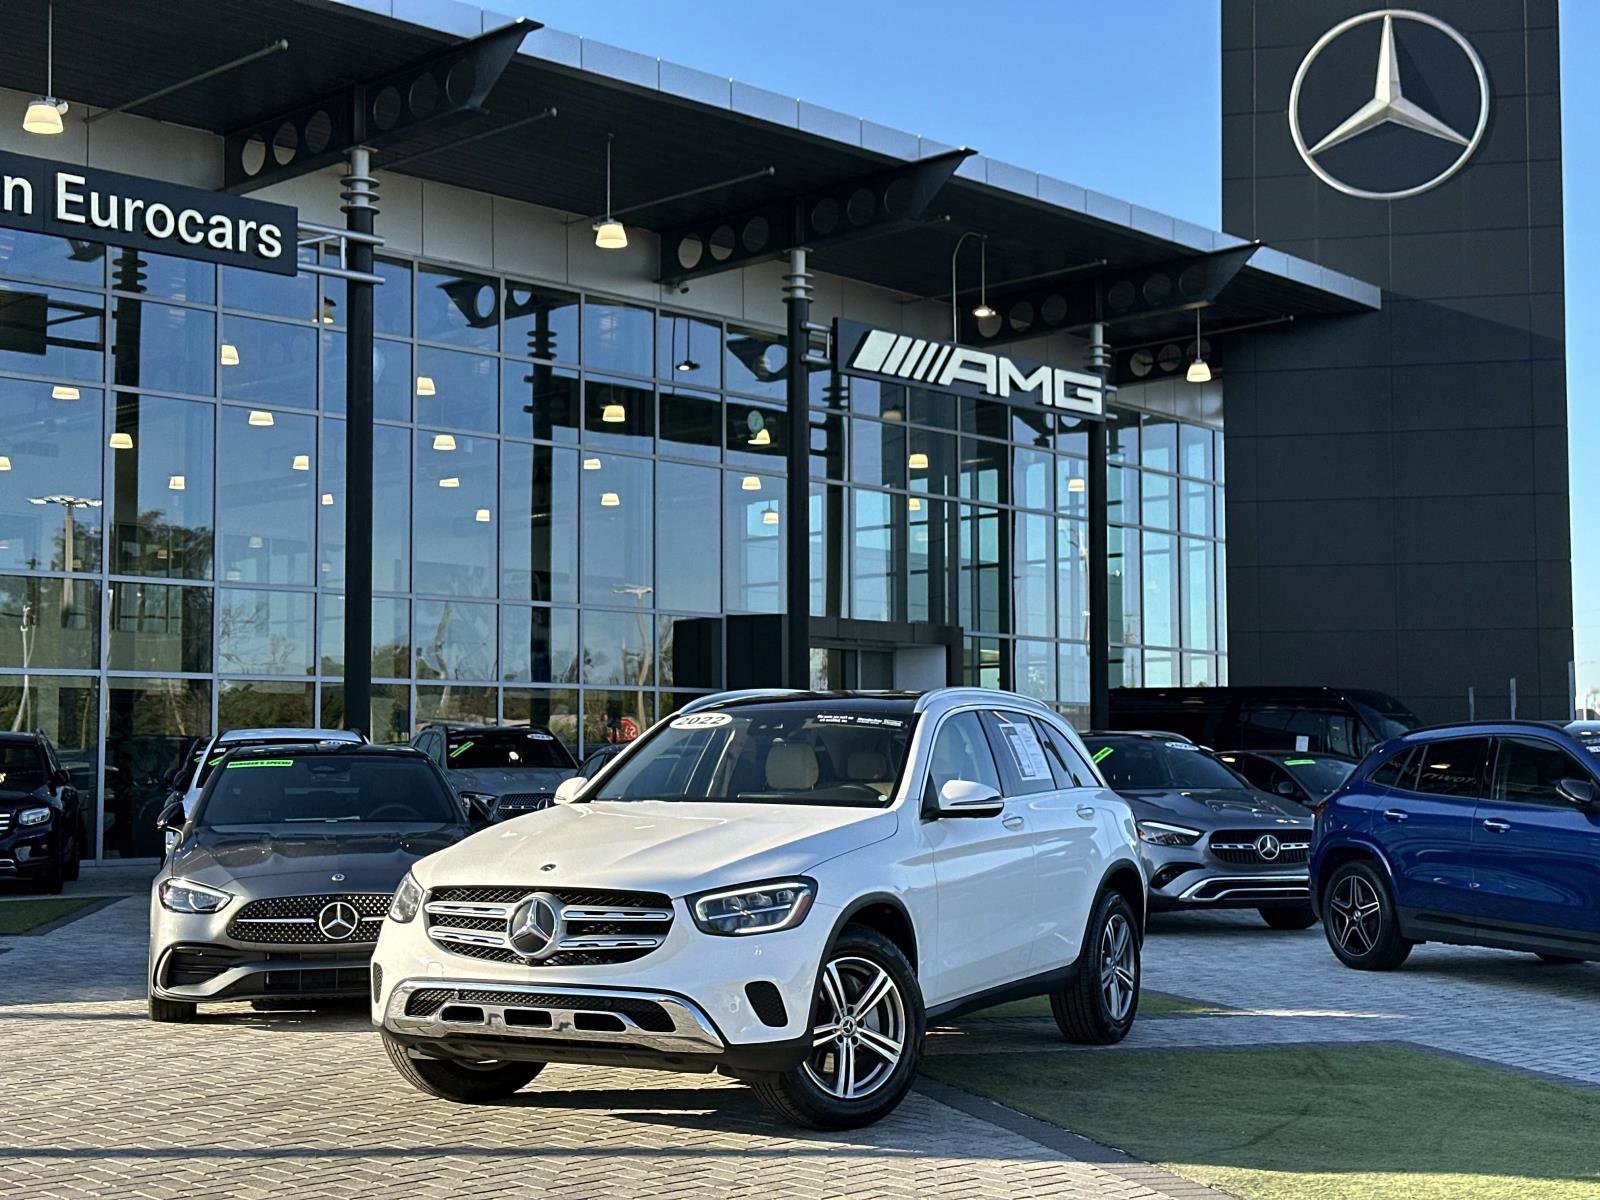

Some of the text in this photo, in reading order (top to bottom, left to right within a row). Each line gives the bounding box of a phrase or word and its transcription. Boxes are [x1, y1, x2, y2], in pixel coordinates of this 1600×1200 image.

[56, 172, 282, 258] Eurocars
[938, 347, 1102, 415] AMG
[674, 716, 726, 726] 2022
